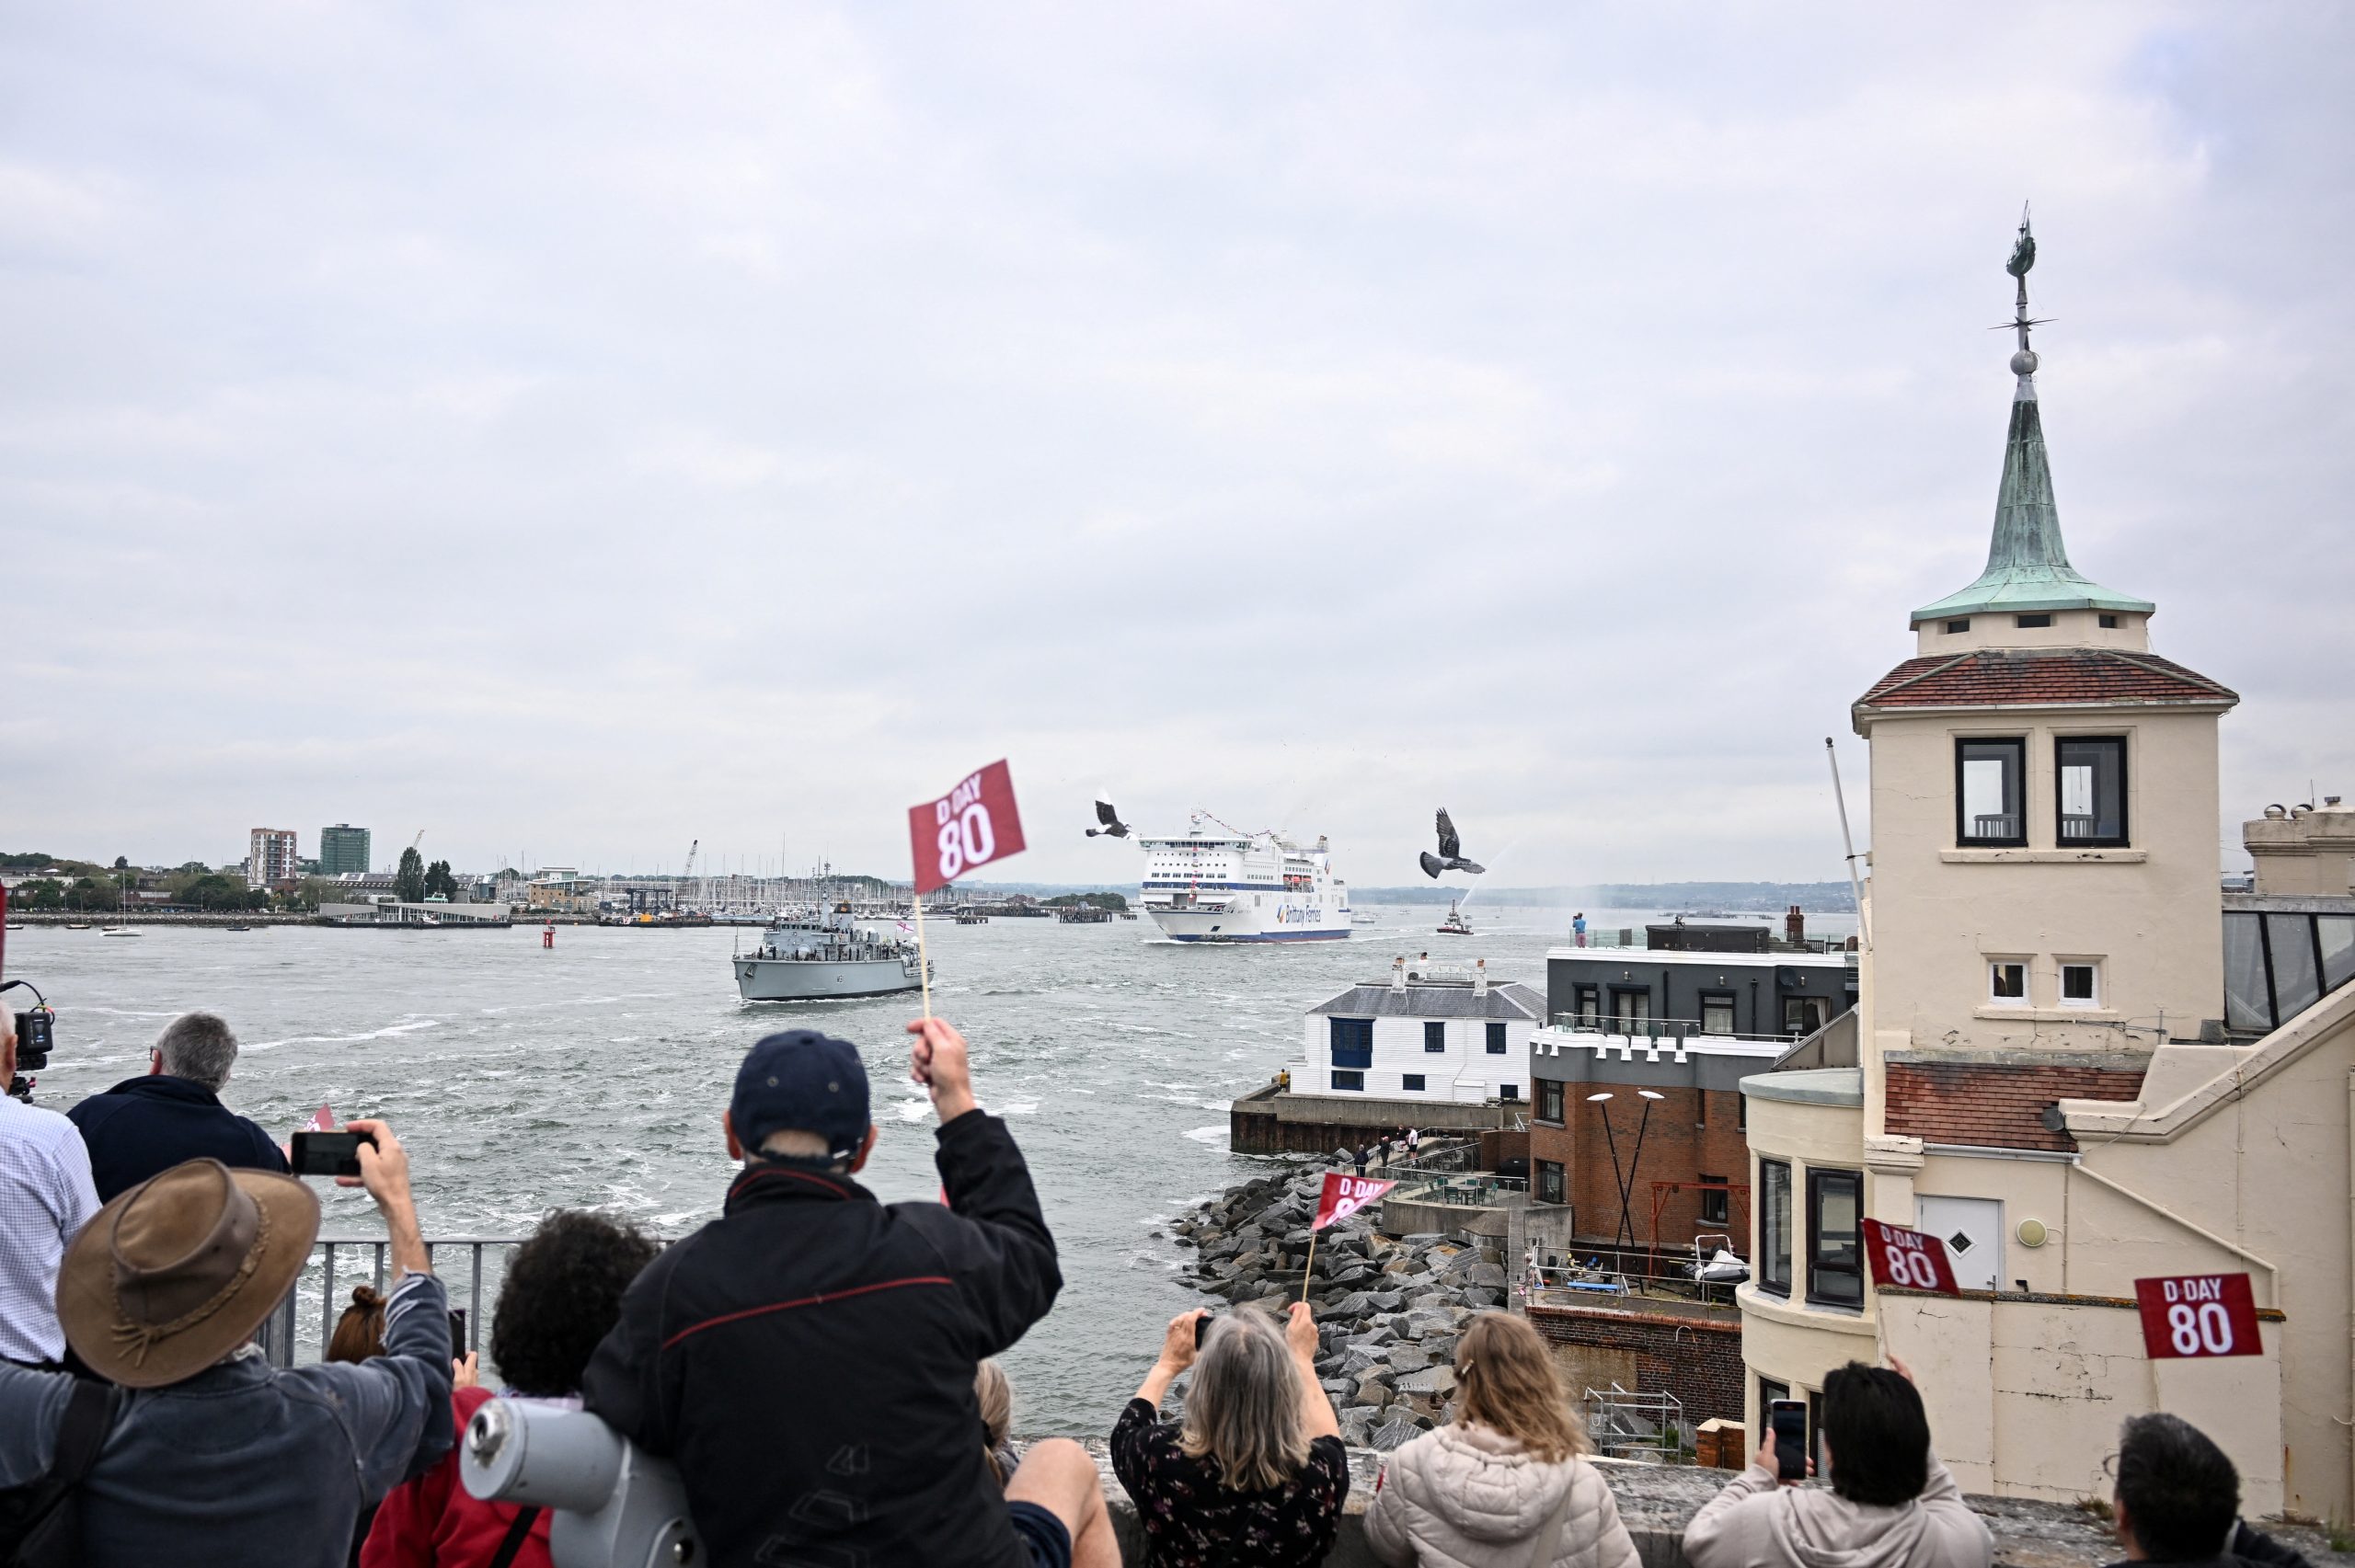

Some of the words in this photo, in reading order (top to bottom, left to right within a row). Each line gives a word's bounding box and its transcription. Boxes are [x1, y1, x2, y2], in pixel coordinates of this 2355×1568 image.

[937, 803, 995, 879] 80
[1285, 904, 1304, 927] Brittany
[1305, 904, 1321, 923] Ferries
[1885, 1245, 1938, 1288] 80
[2167, 1302, 2234, 1355] 80
